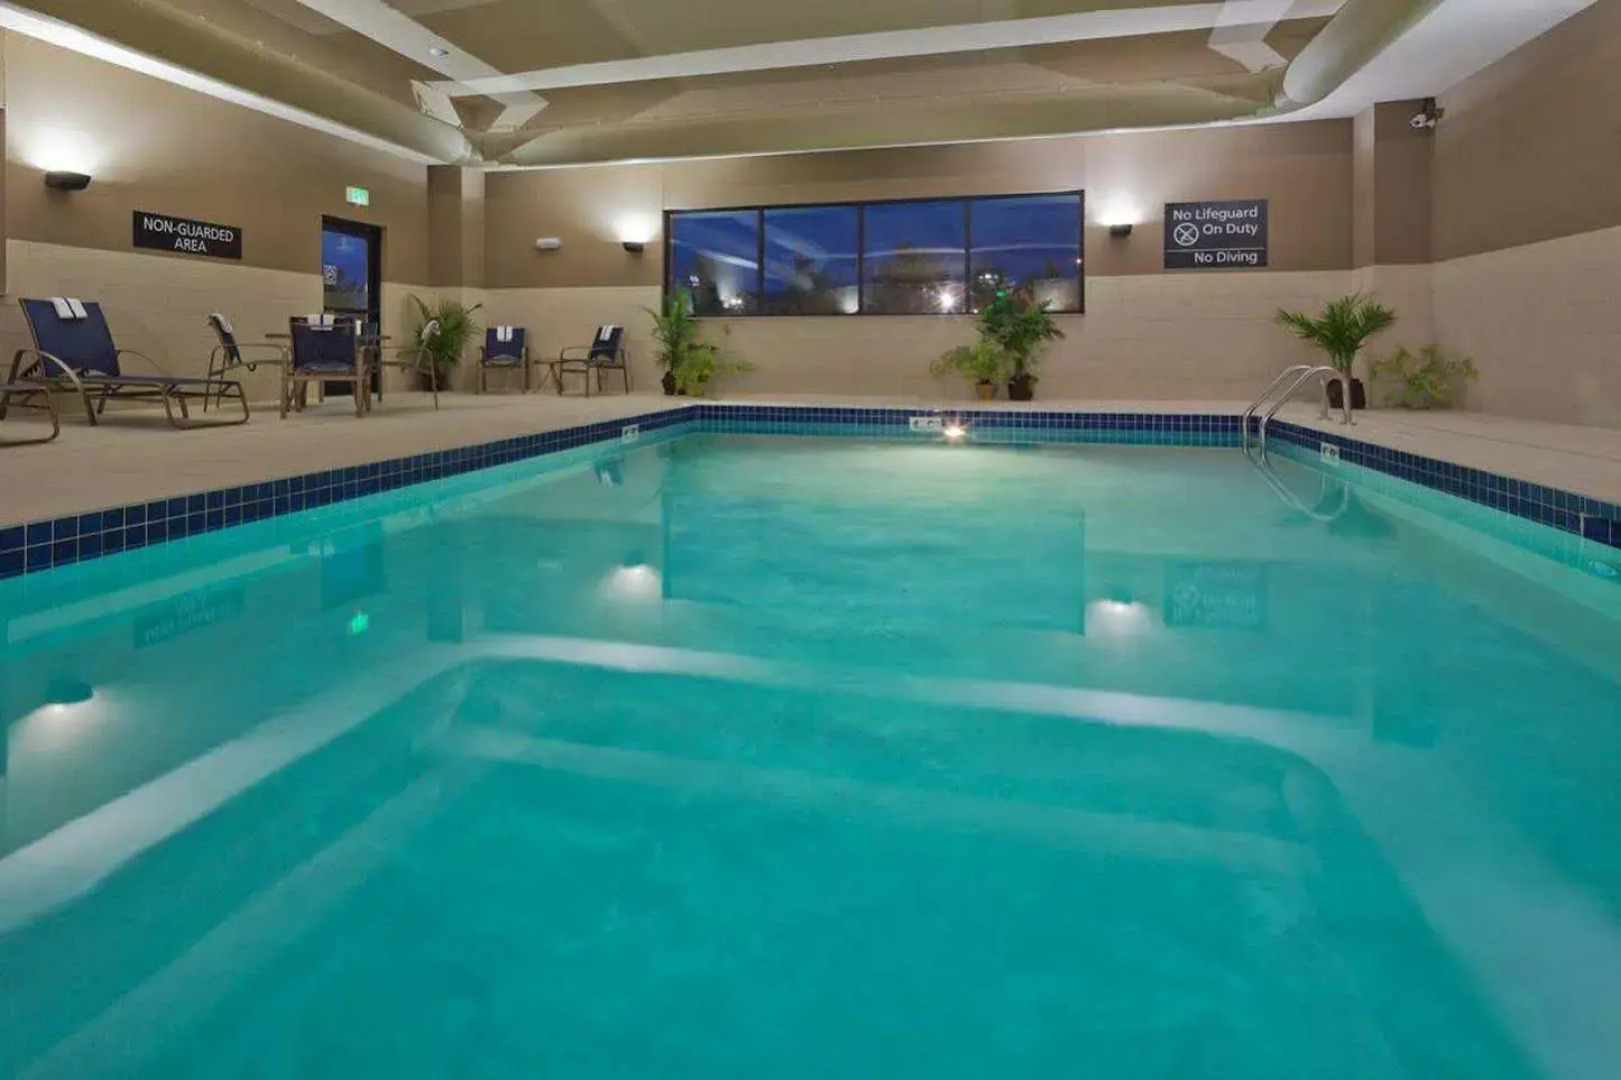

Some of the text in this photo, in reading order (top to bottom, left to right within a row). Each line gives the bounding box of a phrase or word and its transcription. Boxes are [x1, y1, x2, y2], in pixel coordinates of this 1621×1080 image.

[1173, 205, 1258, 221] No Lifeguard
[143, 217, 234, 242] NON-GUARDED
[1202, 222, 1258, 236] On Duty
[174, 238, 208, 253] AREA
[1194, 250, 1258, 265] No Diving
